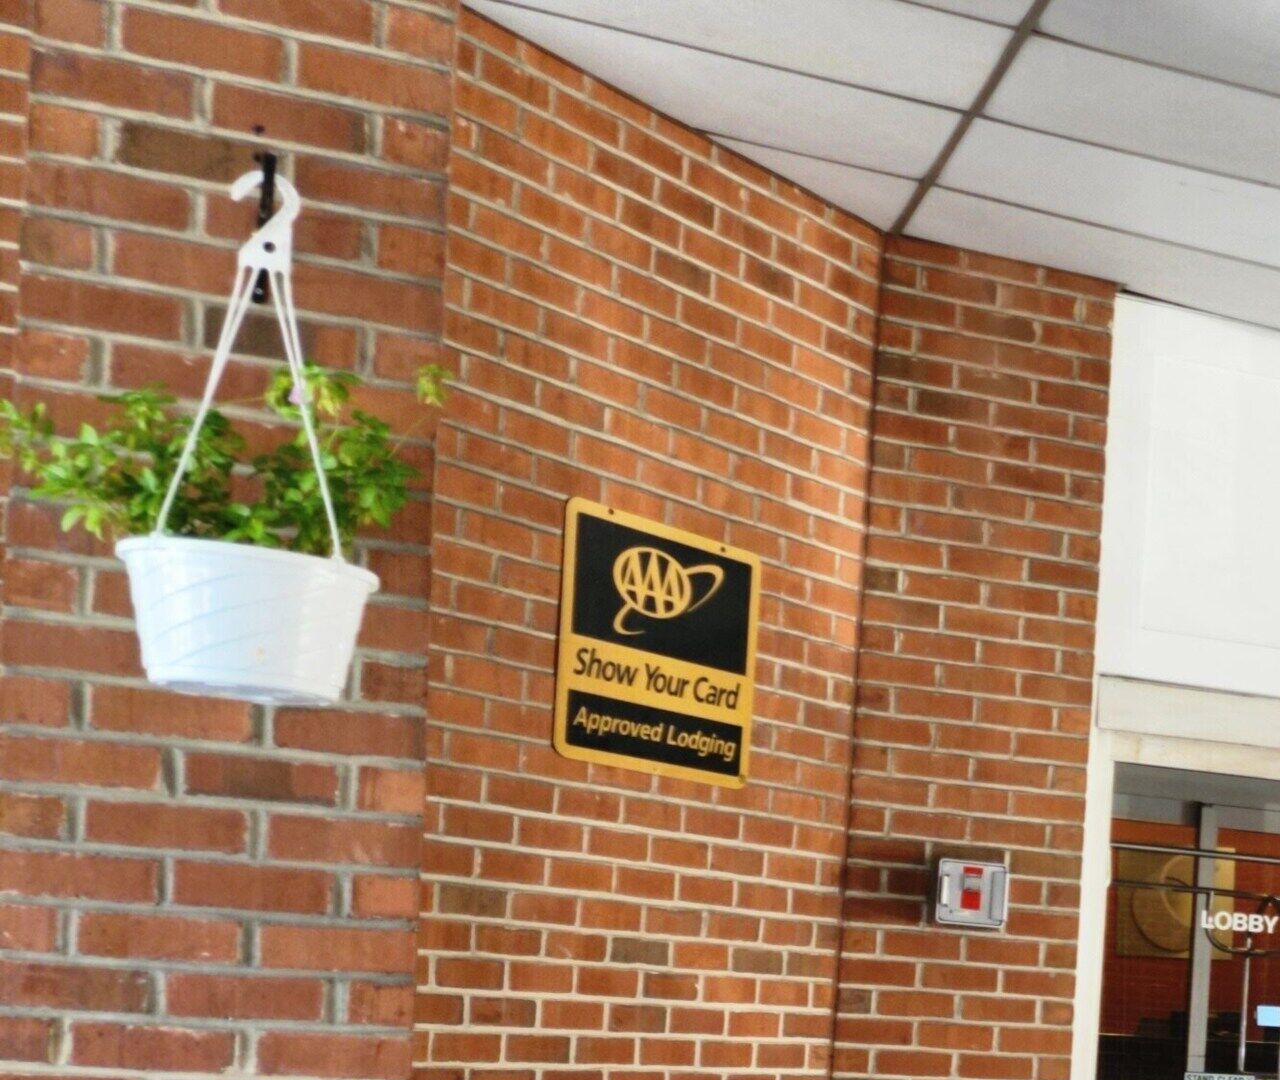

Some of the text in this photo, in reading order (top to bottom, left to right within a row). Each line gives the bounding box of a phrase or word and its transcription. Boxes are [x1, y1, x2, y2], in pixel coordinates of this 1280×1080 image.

[613, 547, 691, 619] AAA
[573, 647, 740, 710] Show Your Card
[573, 706, 737, 761] Approved Lodging
[1201, 909, 1279, 934] LOBBY
